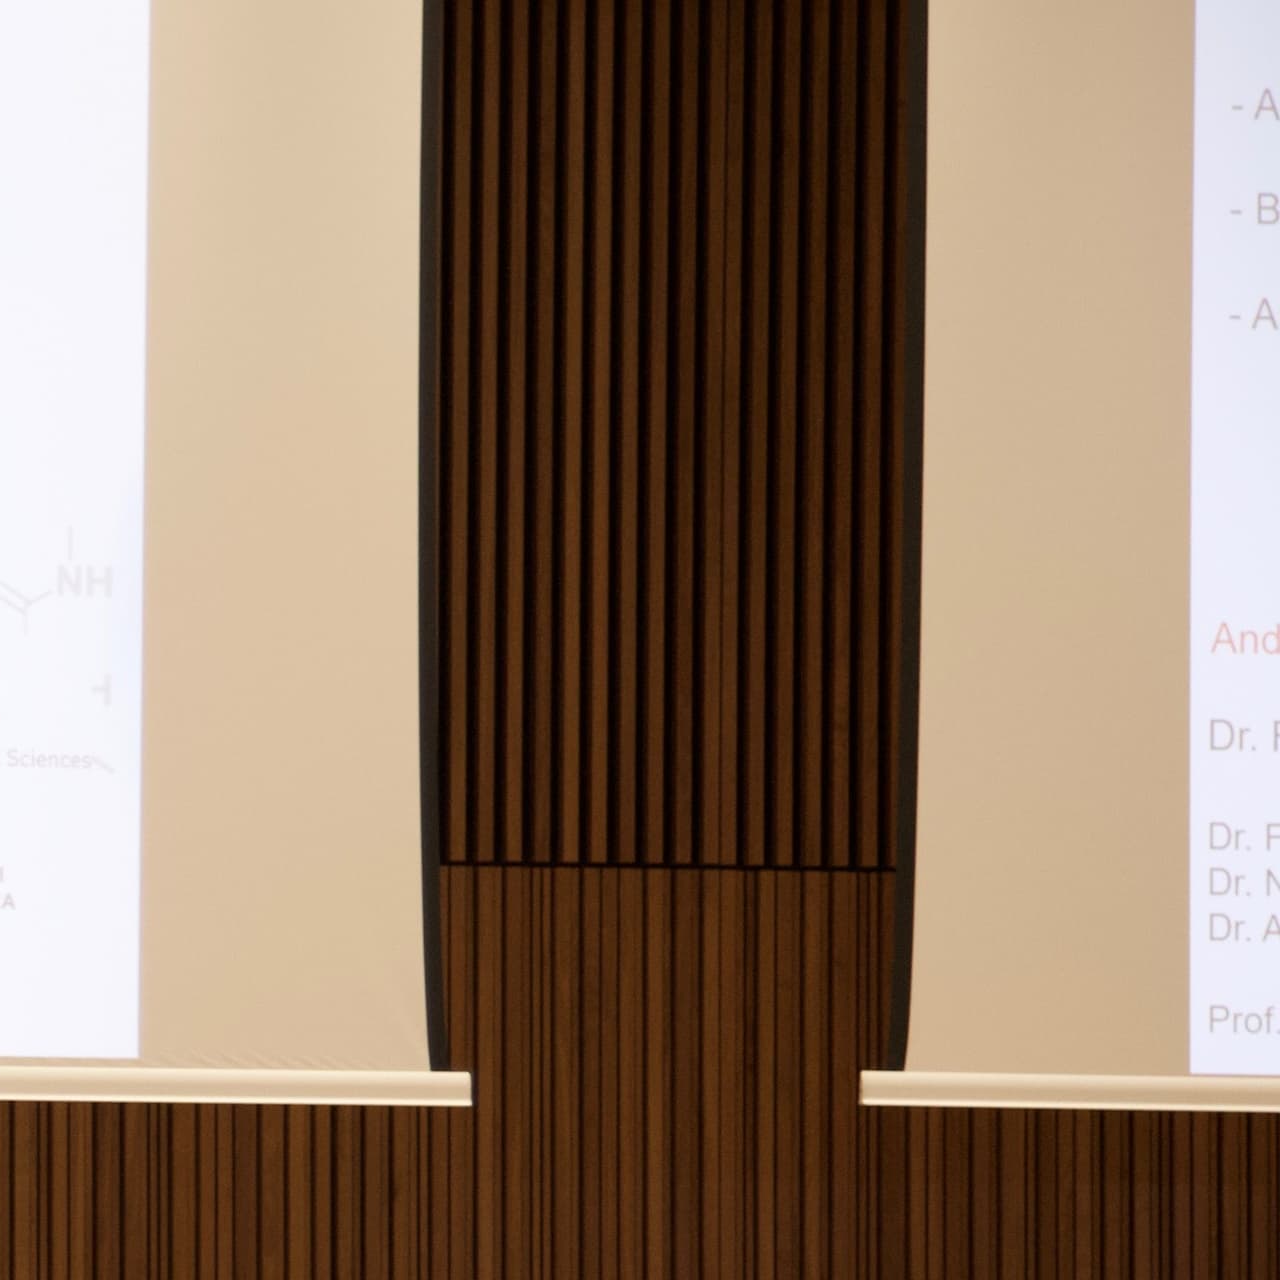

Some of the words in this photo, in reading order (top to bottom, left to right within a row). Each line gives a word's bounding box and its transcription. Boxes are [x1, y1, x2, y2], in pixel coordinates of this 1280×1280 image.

[1210, 620, 1280, 656] And
[1209, 717, 1257, 752] Dr.
[5, 746, 93, 771] Sciences
[1208, 821, 1252, 852] Dr.
[1208, 866, 1252, 897] Dr.
[1208, 912, 1252, 942] Dr.
